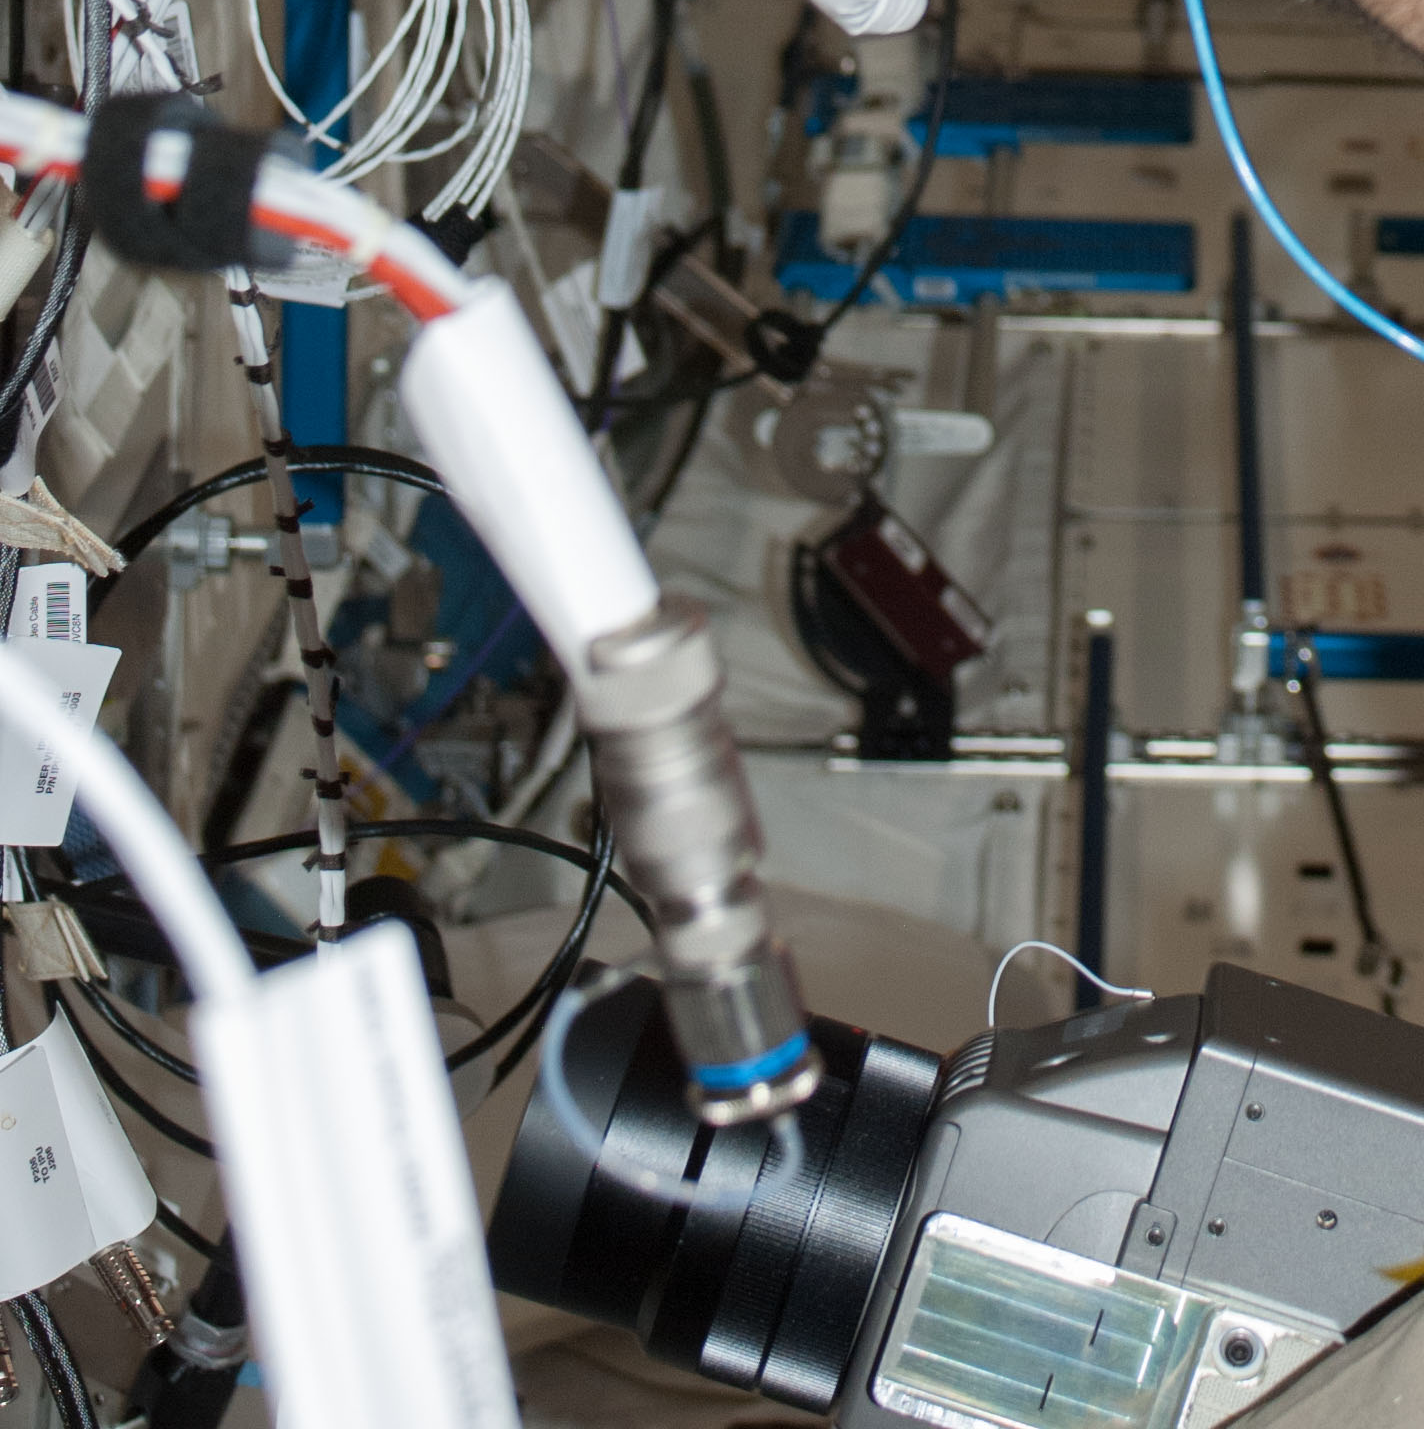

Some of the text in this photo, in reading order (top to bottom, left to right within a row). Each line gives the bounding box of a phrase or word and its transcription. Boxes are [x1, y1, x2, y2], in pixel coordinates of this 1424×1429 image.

[35, 764, 51, 794] USER
[45, 776, 57, 794] P/N
[35, 1145, 51, 1184] TO IPU
